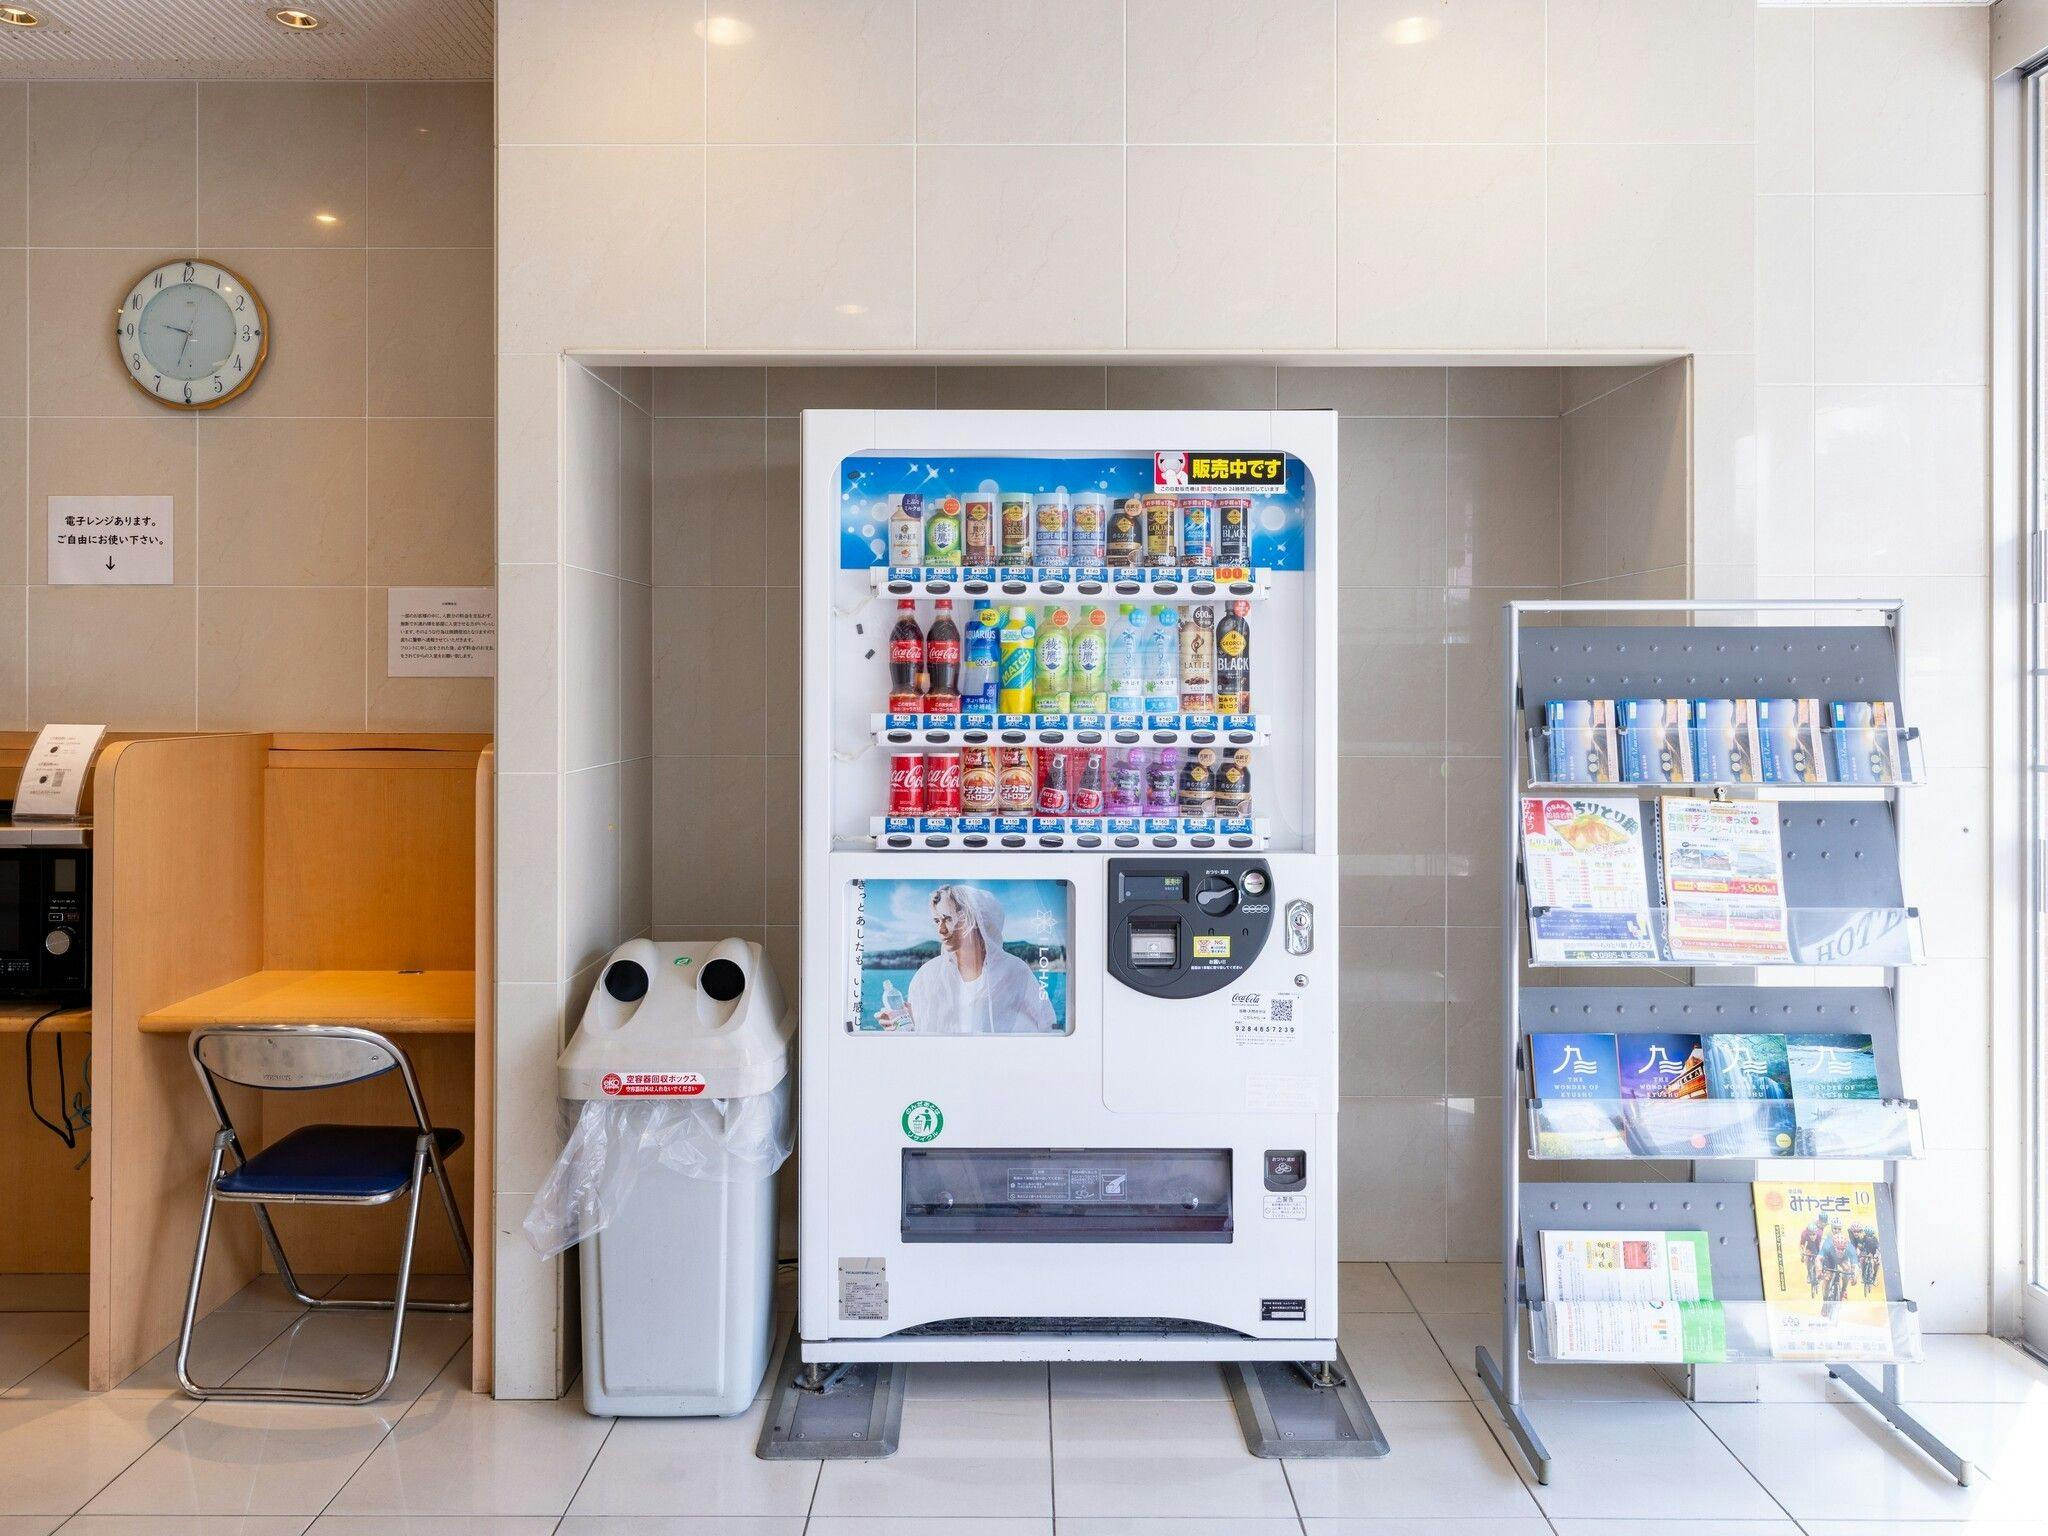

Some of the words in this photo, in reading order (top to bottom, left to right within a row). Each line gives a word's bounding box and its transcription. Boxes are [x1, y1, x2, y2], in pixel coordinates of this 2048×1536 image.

[153, 272, 163, 289] 11
[183, 266, 195, 283] 12
[216, 273, 221, 289] 1
[132, 293, 143, 310] 10
[235, 295, 244, 311] 2
[126, 323, 135, 341] 9
[241, 324, 251, 342] 3
[132, 353, 141, 370] 8
[233, 354, 242, 371] 4
[154, 374, 162, 392] 7
[183, 381, 193, 399] 6
[213, 375, 223, 393] 5
[1192, 458, 1282, 479] 販売中です
[64, 515, 156, 527] 電子レンジあります。
[57, 534, 164, 545] ご自由にお使い下さい。
[892, 646, 922, 659] Coca-Cola
[929, 646, 958, 659] Coca-Cola
[1217, 658, 1249, 670] BLACK
[966, 793, 992, 801] ストロング
[1004, 792, 1029, 800] ストロング
[1038, 946, 1049, 1001] LOHAS
[1231, 992, 1261, 1003] Coca-Cola
[626, 1074, 698, 1084] 空容器回収ボックス
[1855, 1190, 1870, 1206] 10
